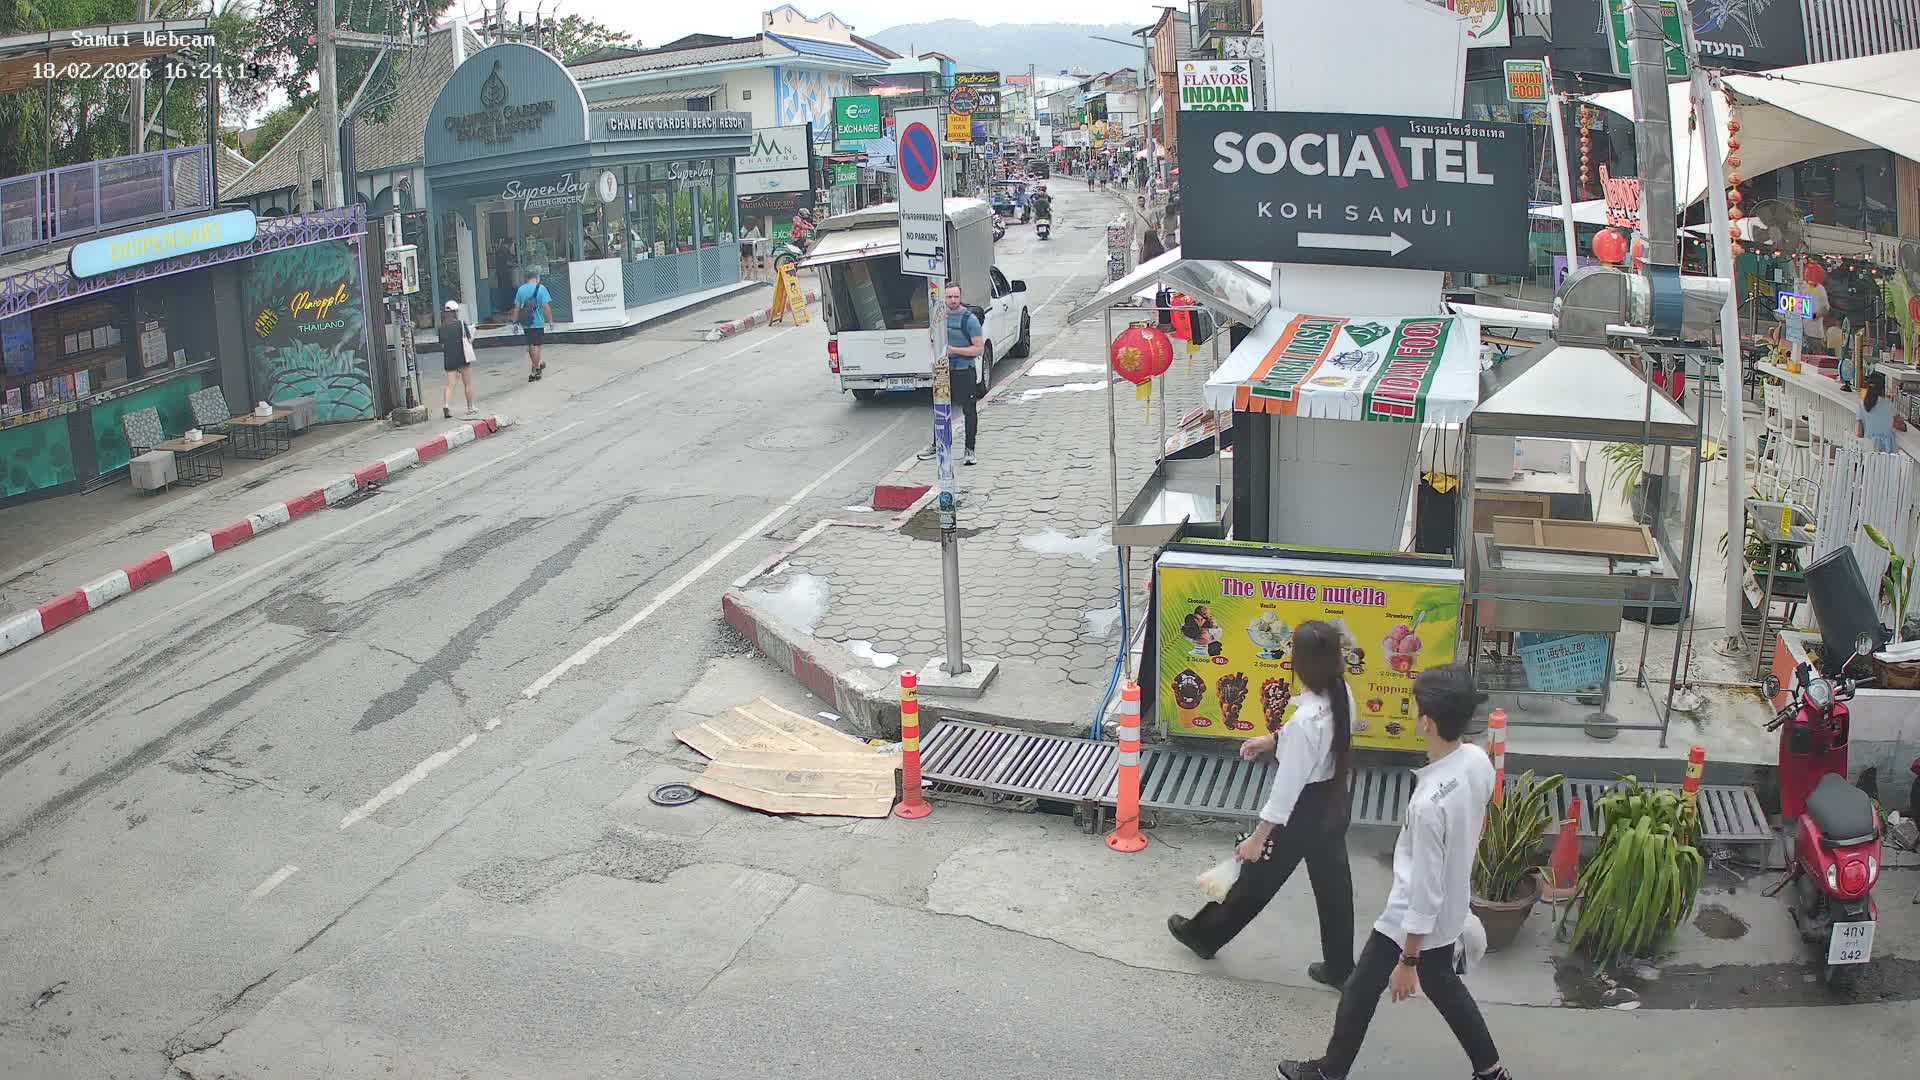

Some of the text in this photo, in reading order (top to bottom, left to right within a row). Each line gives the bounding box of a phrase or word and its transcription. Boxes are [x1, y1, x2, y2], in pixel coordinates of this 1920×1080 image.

[1184, 74, 1248, 85] FLAVORS
[1508, 72, 1542, 84] INDIAN
[1183, 86, 1249, 103] INDIAN
[1512, 85, 1542, 98] FOOD
[611, 117, 746, 131] CHAWENG GARDEN BEACH RESORT
[839, 123, 879, 134] EXCHANGE
[1408, 120, 1505, 139] โรงแรมโซเชียลเทล
[528, 198, 551, 208] GREEN
[1257, 201, 1451, 226] KOH SAMUI
[110, 220, 223, 263] DISPENSARY
[906, 232, 938, 242] NO PARKING
[291, 283, 350, 319] Pineapple
[1780, 295, 1810, 315] OPEN
[298, 320, 345, 333] THAILAND
[1220, 577, 1387, 607] The Waffle nutella
[1325, 607, 1345, 615] Coconut
[1385, 612, 1414, 620] Strawberry
[1840, 950, 1862, 961] 342
